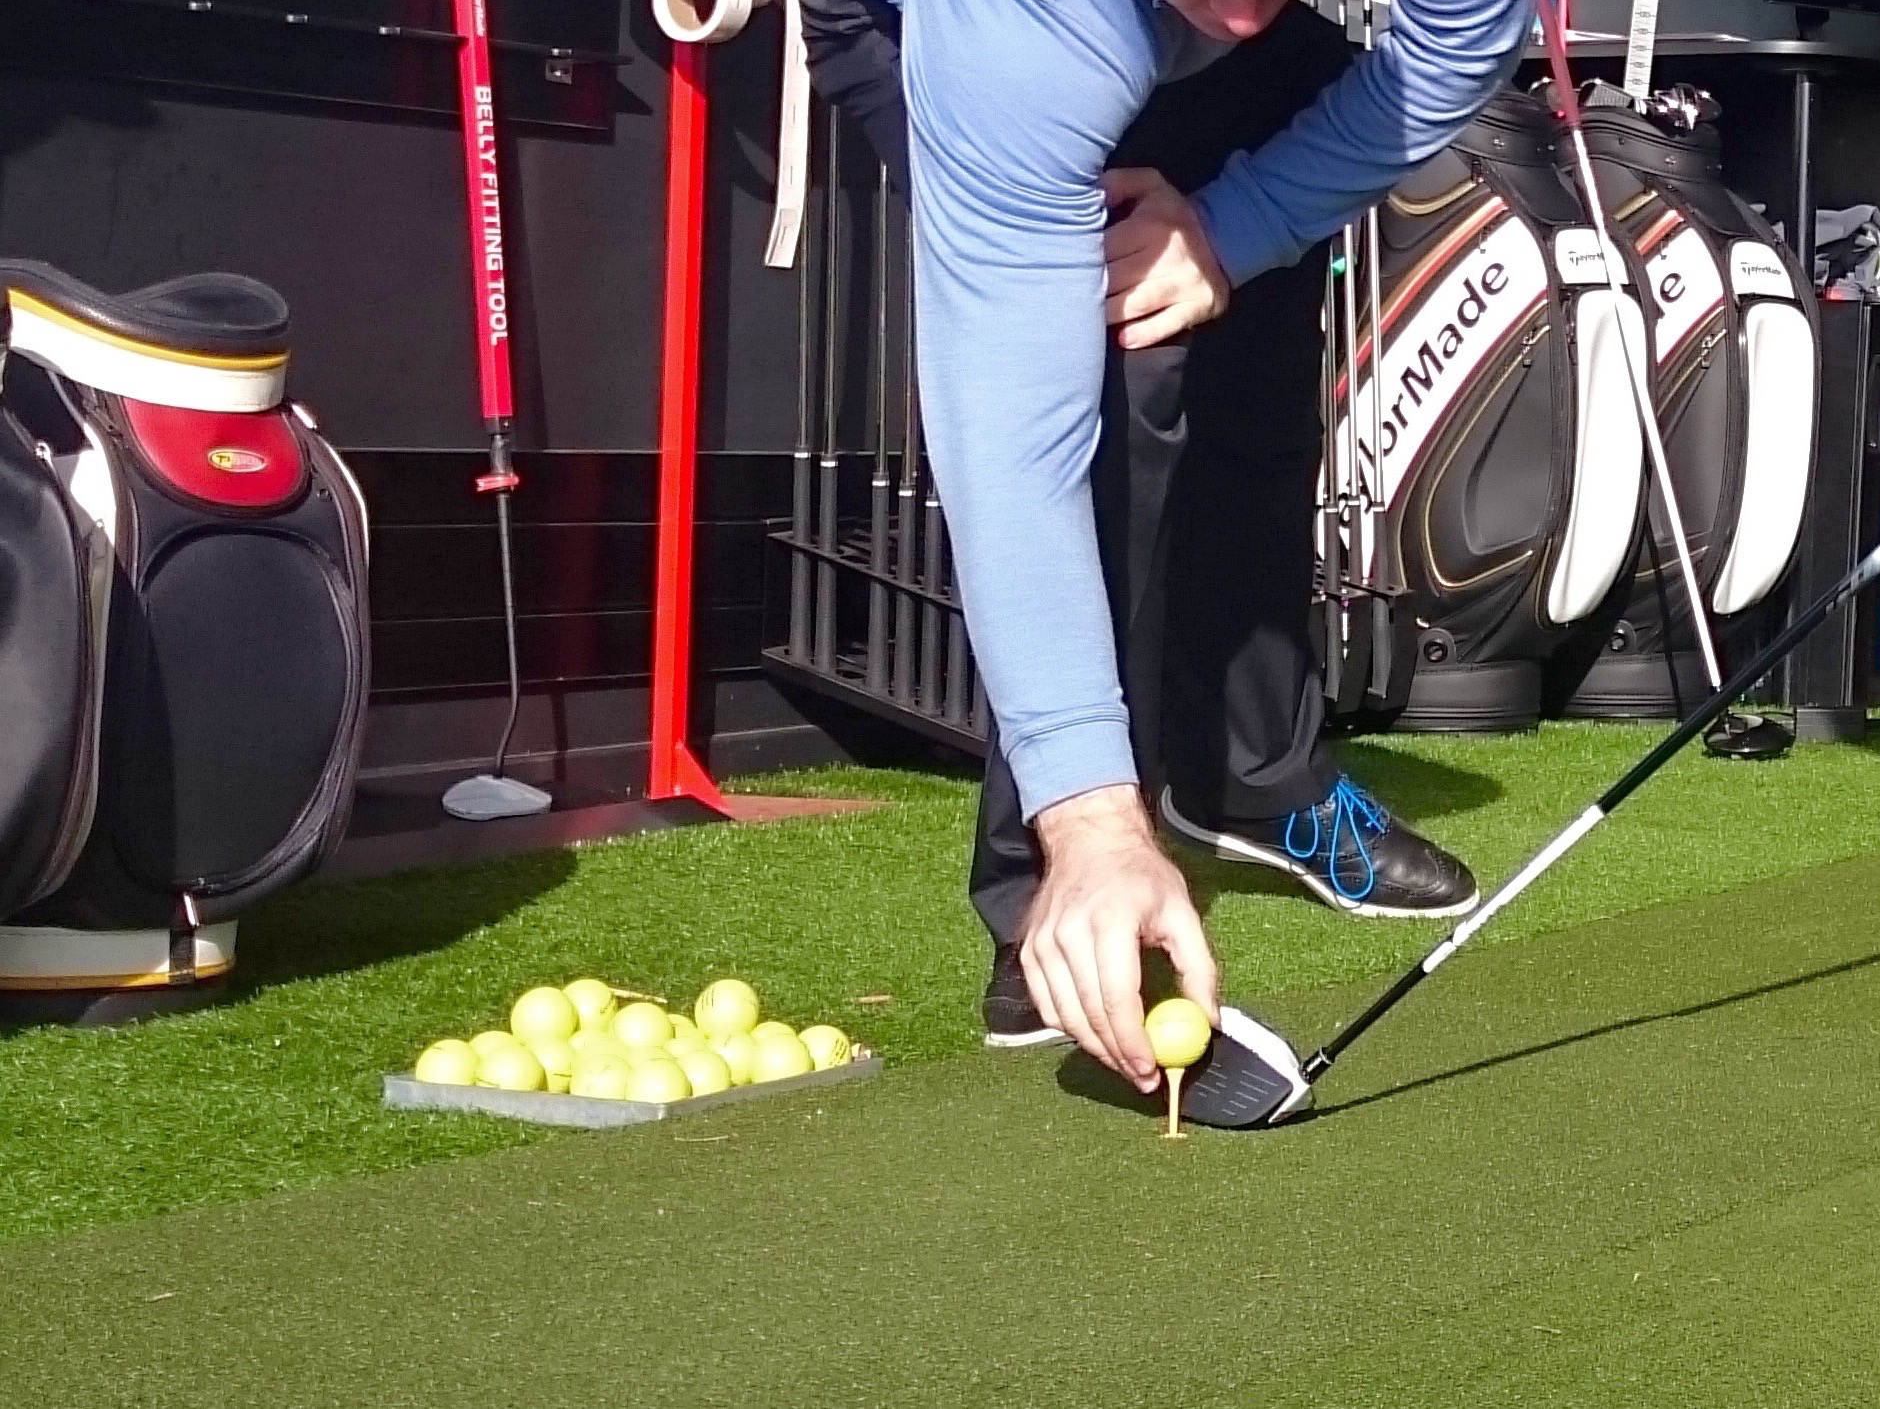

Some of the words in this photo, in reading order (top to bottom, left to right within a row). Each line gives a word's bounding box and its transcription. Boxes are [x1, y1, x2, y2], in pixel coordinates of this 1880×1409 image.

[474, 85, 497, 165] BELLY
[480, 173, 504, 272] FITTING
[487, 277, 509, 347] TOOL
